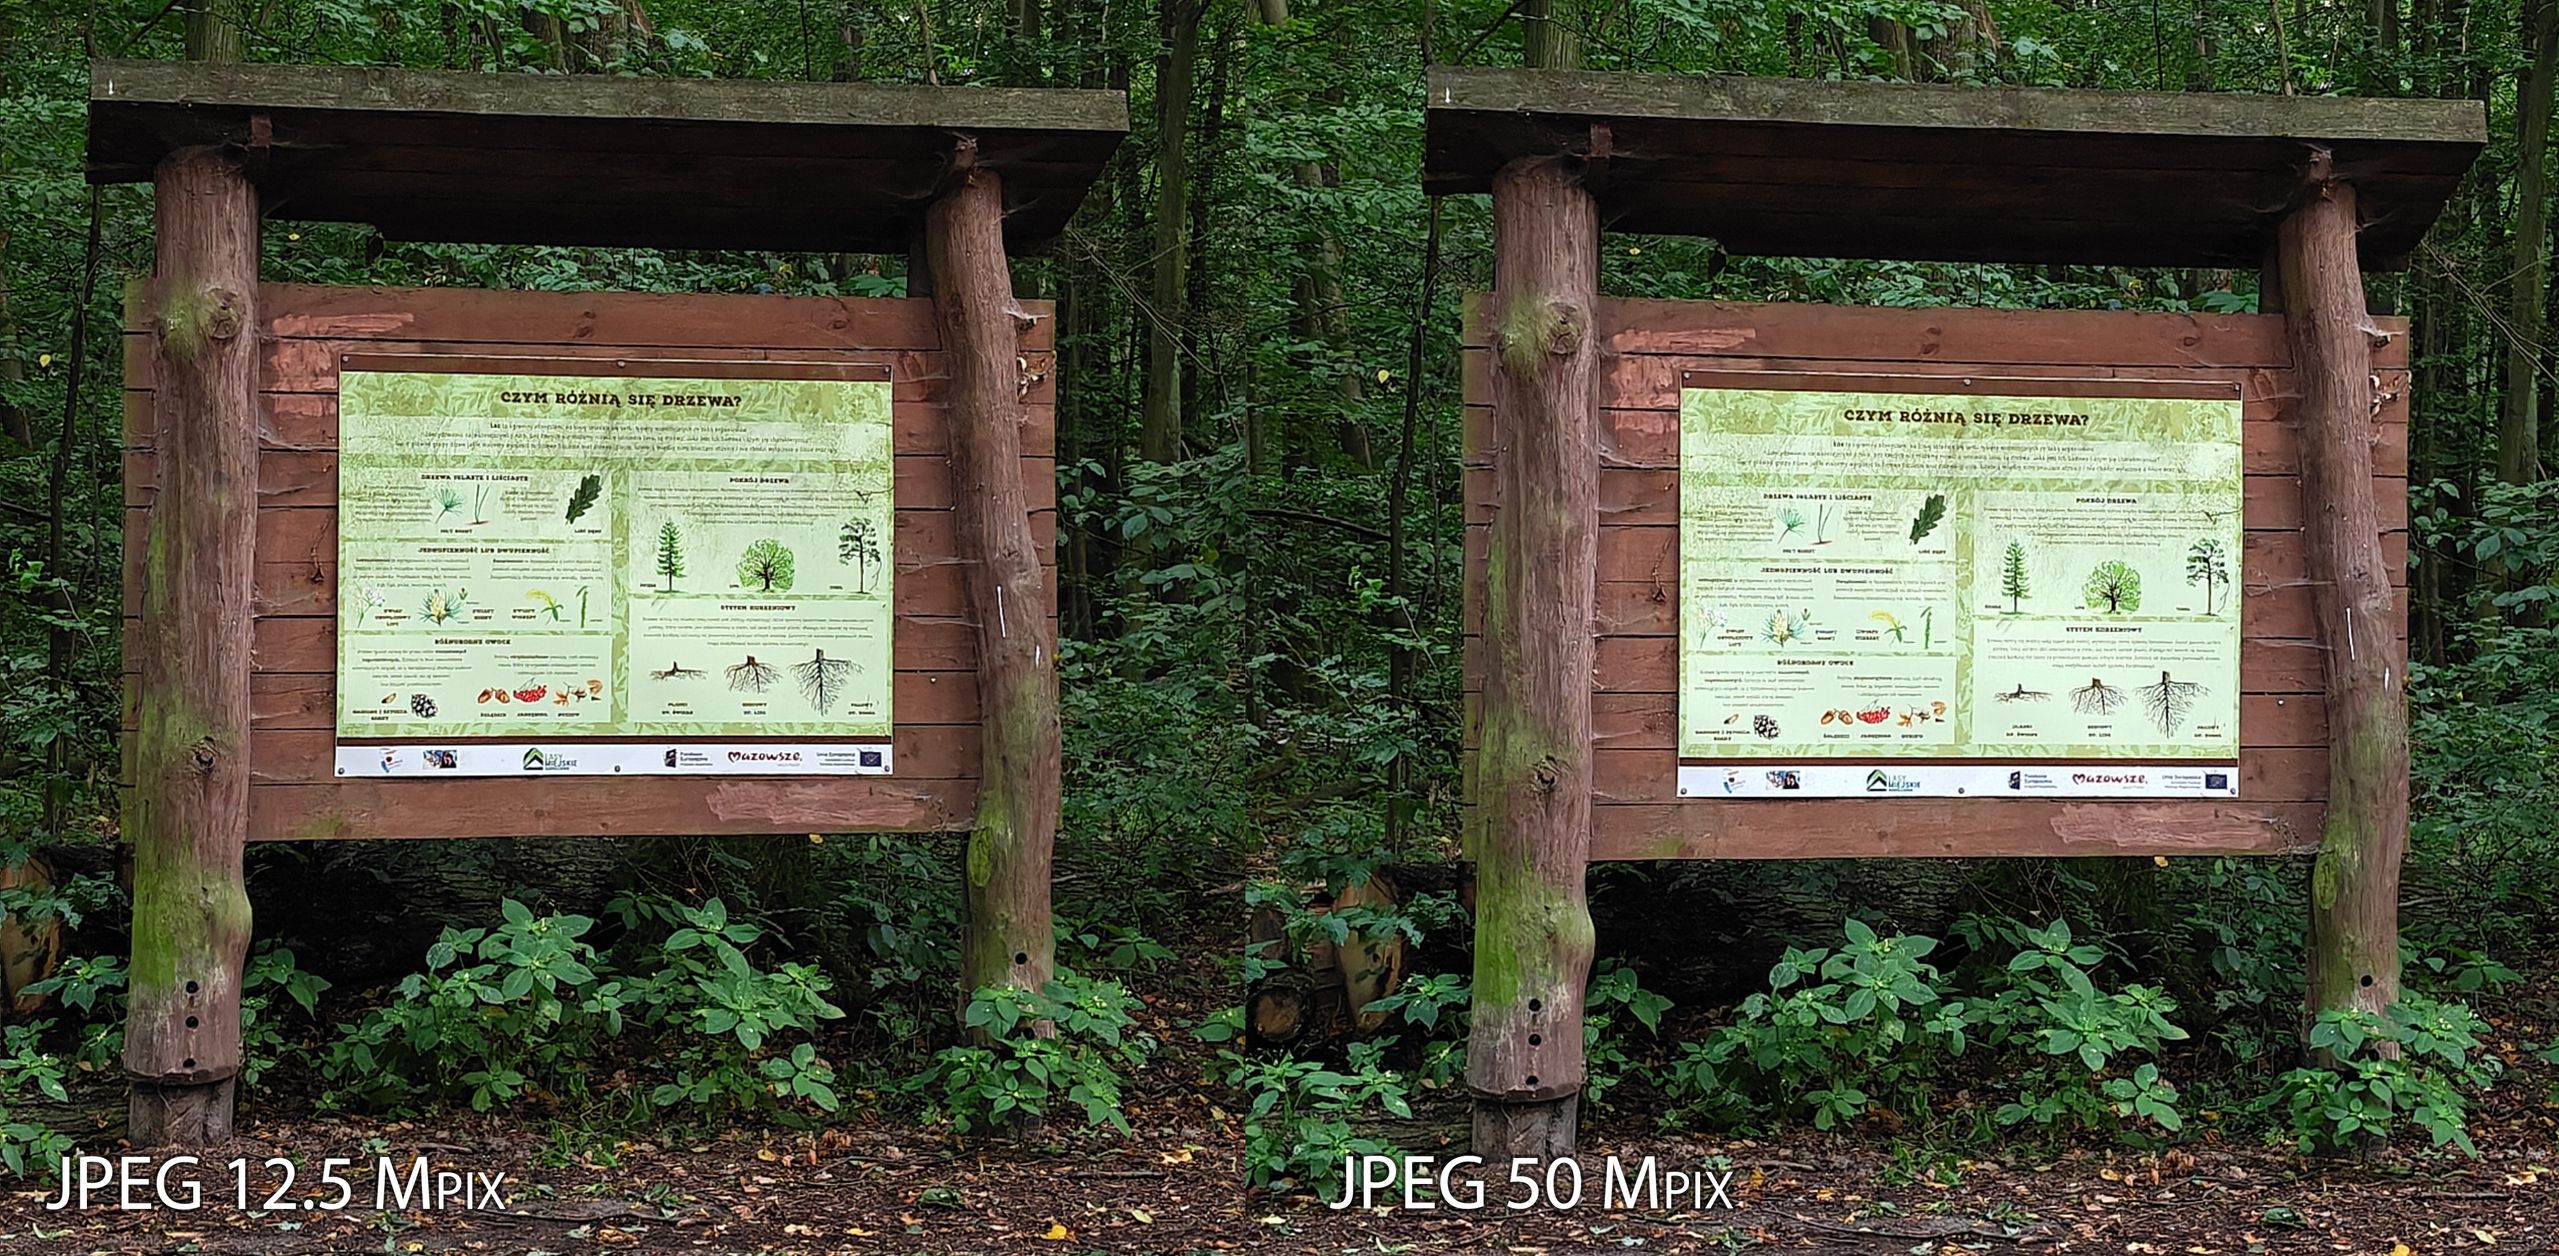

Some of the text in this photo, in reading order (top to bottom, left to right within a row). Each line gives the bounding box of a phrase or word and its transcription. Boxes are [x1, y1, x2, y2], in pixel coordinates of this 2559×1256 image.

[500, 390, 742, 408] CZYM RÓŻNIĄ SIĘ DRZEWA?
[1844, 408, 2089, 427] CZYM RÓŻNIĄ SIĘ DRZEWA?
